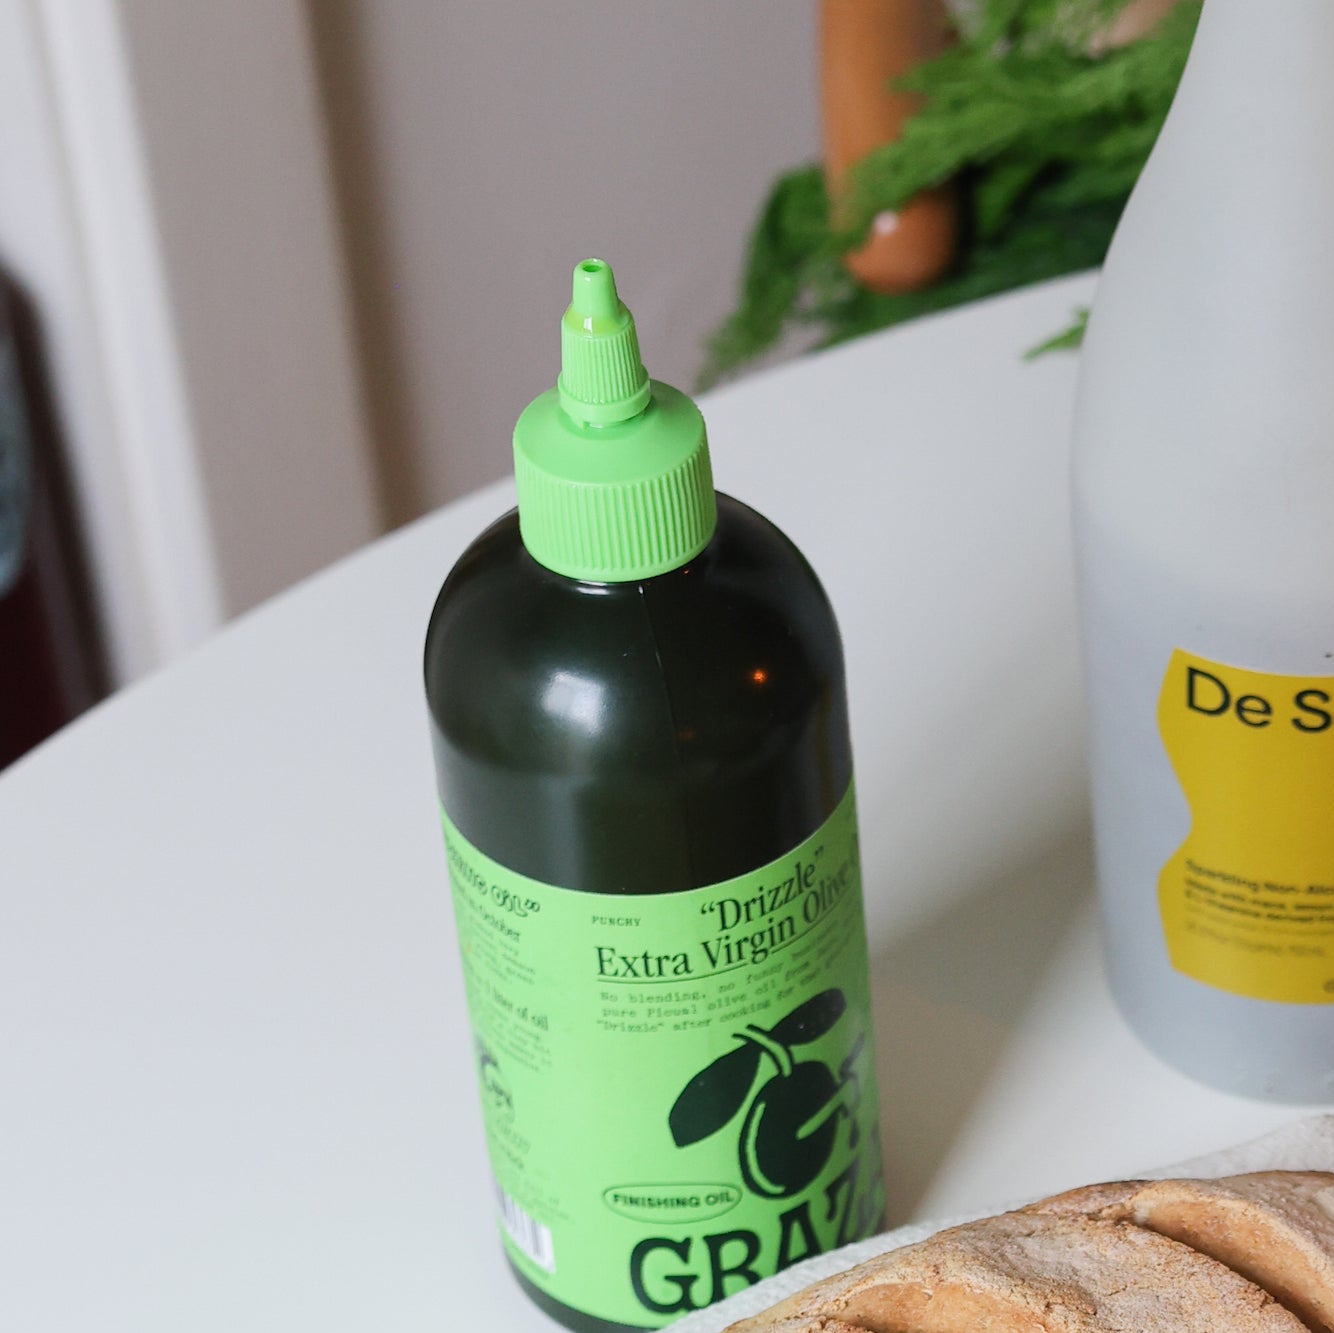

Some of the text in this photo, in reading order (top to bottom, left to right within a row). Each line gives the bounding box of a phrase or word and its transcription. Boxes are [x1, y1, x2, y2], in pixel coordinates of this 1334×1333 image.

[1186, 666, 1273, 728] De
[591, 914, 642, 927] PUNCHY
[593, 945, 695, 979] Extra
[700, 915, 797, 970] Virgin
[612, 1190, 736, 1209] FINISHING OIL
